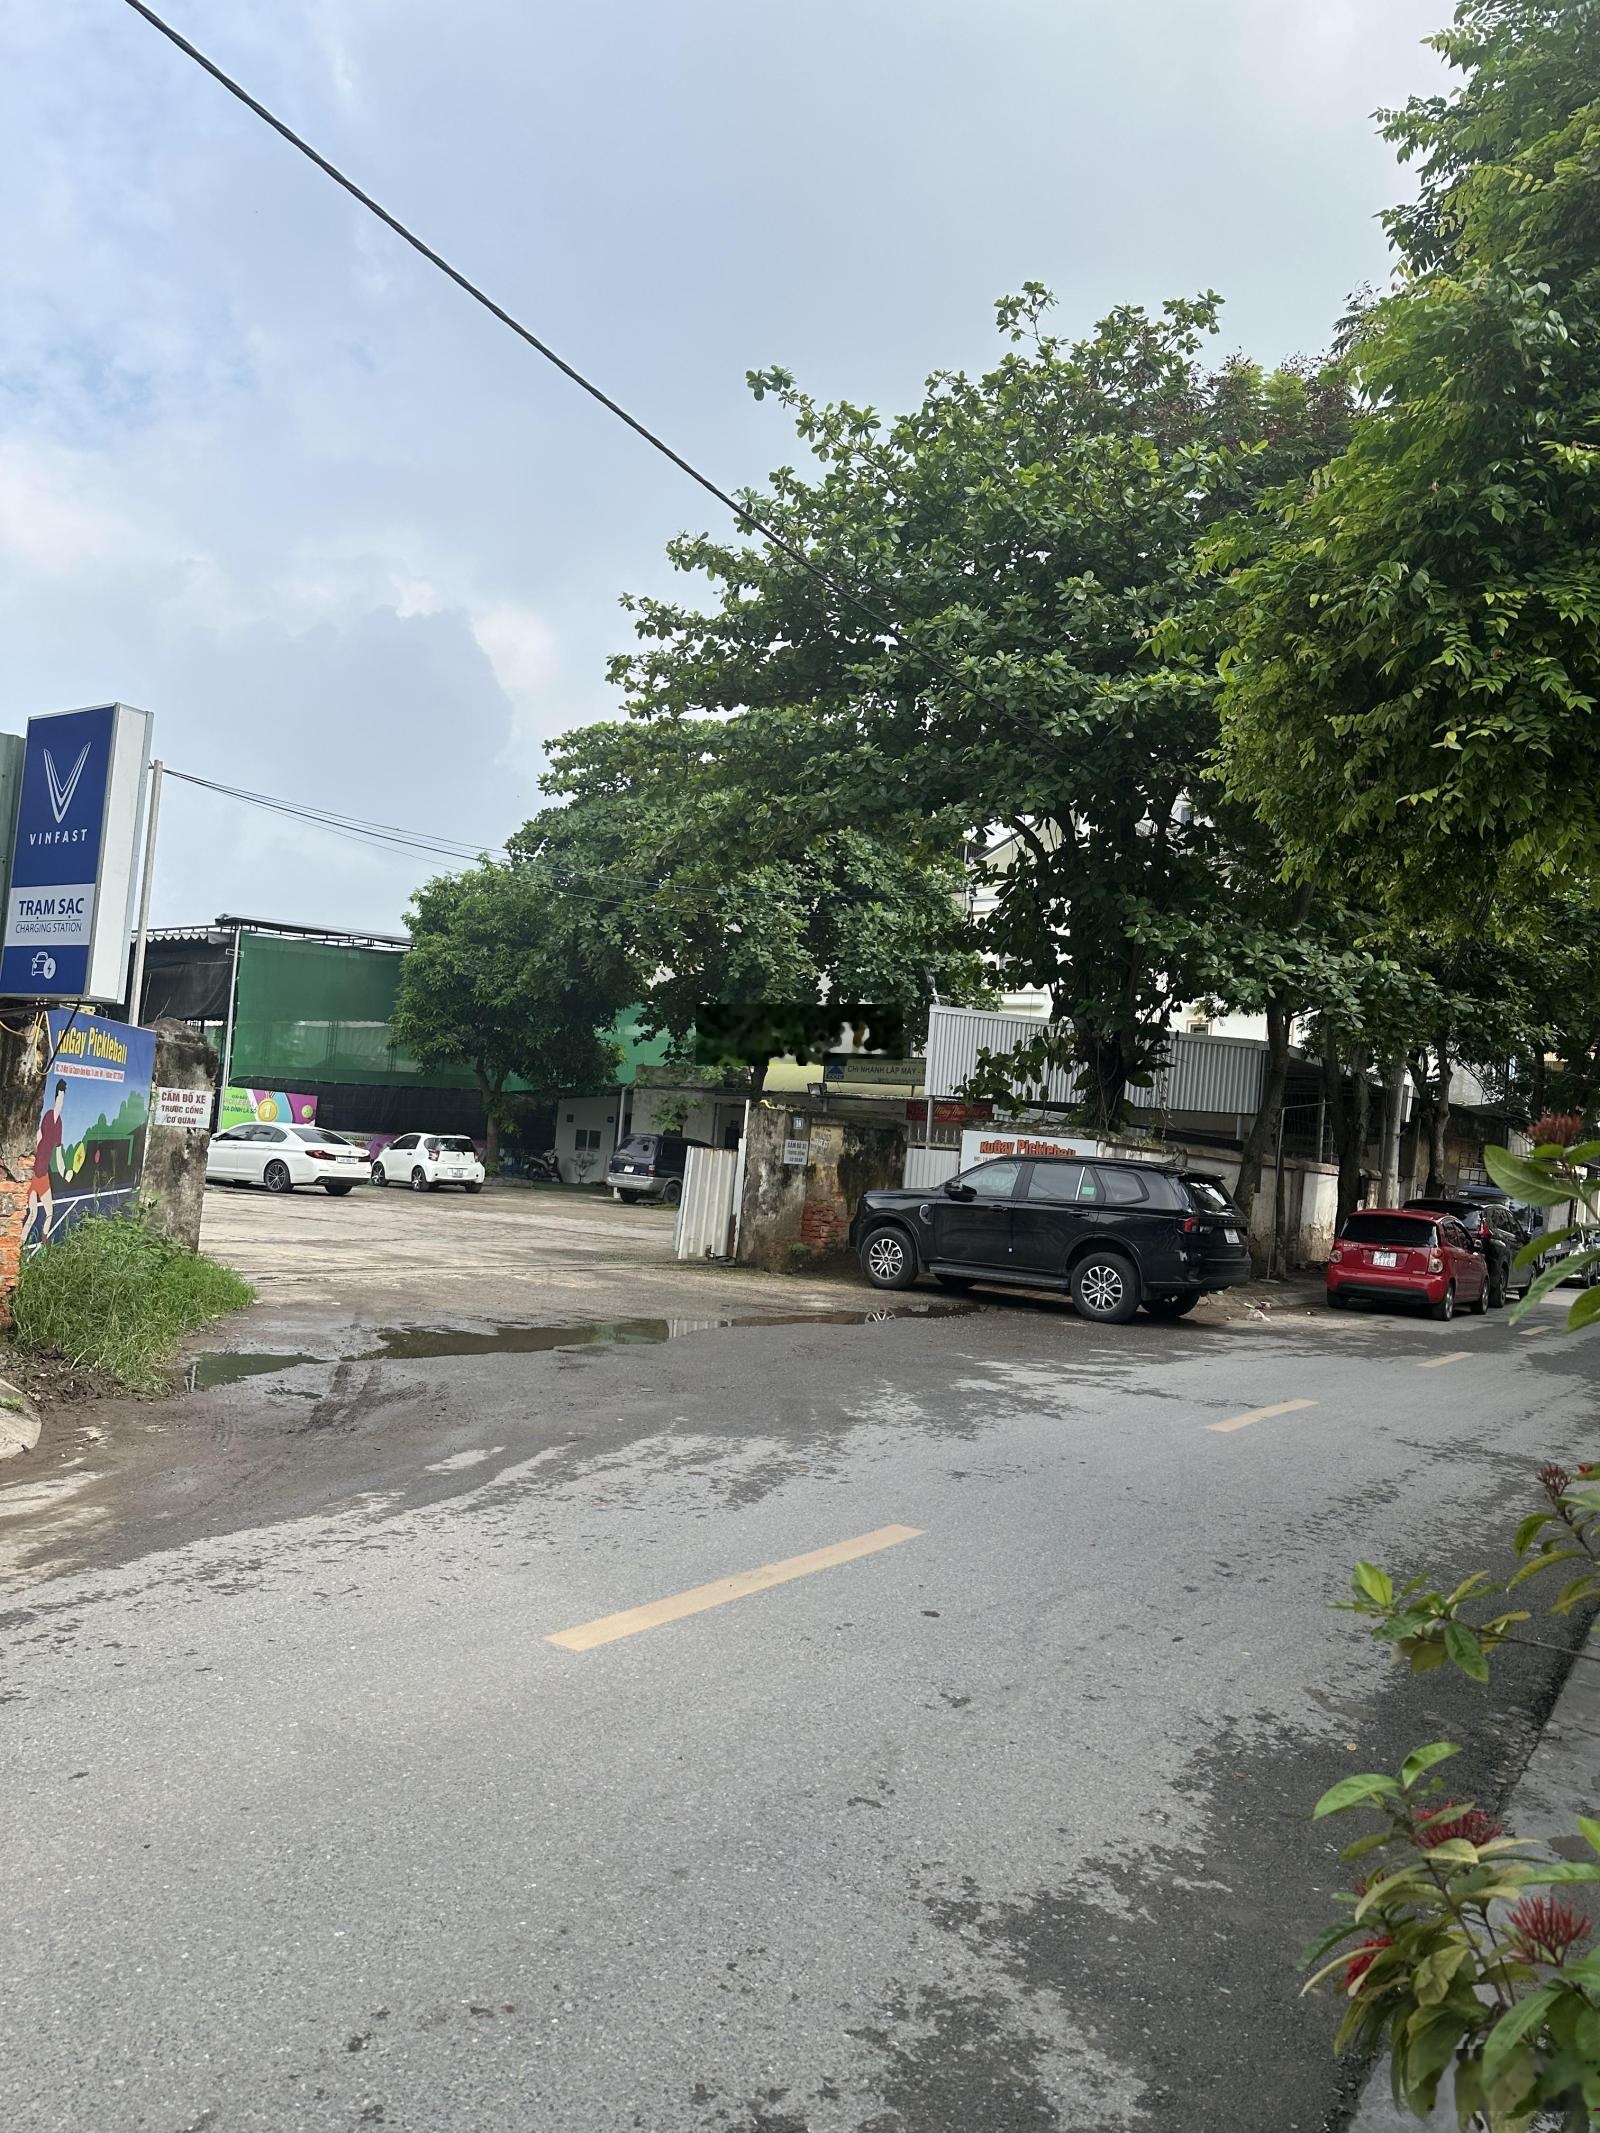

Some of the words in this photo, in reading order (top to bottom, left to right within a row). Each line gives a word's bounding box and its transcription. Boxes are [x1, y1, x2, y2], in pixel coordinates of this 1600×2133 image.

[29, 828, 88, 846] VINFAST
[18, 899, 56, 920] TRẠM
[57, 897, 85, 919] SẠC
[15, 922, 52, 934] CHARGING
[52, 921, 83, 933] STATION
[57, 1027, 87, 1058] KuGay
[87, 1027, 128, 1064] Pickleball
[161, 1089, 181, 1103] CẤM
[182, 1090, 194, 1104] ĐỖ
[195, 1094, 207, 1105] XE
[161, 1103, 184, 1114] TRƯỚC
[185, 1104, 205, 1115] CỔNG
[166, 1116, 177, 1124] CƠ
[177, 1116, 197, 1125] QUAN
[980, 1139, 1016, 1155] KuGay
